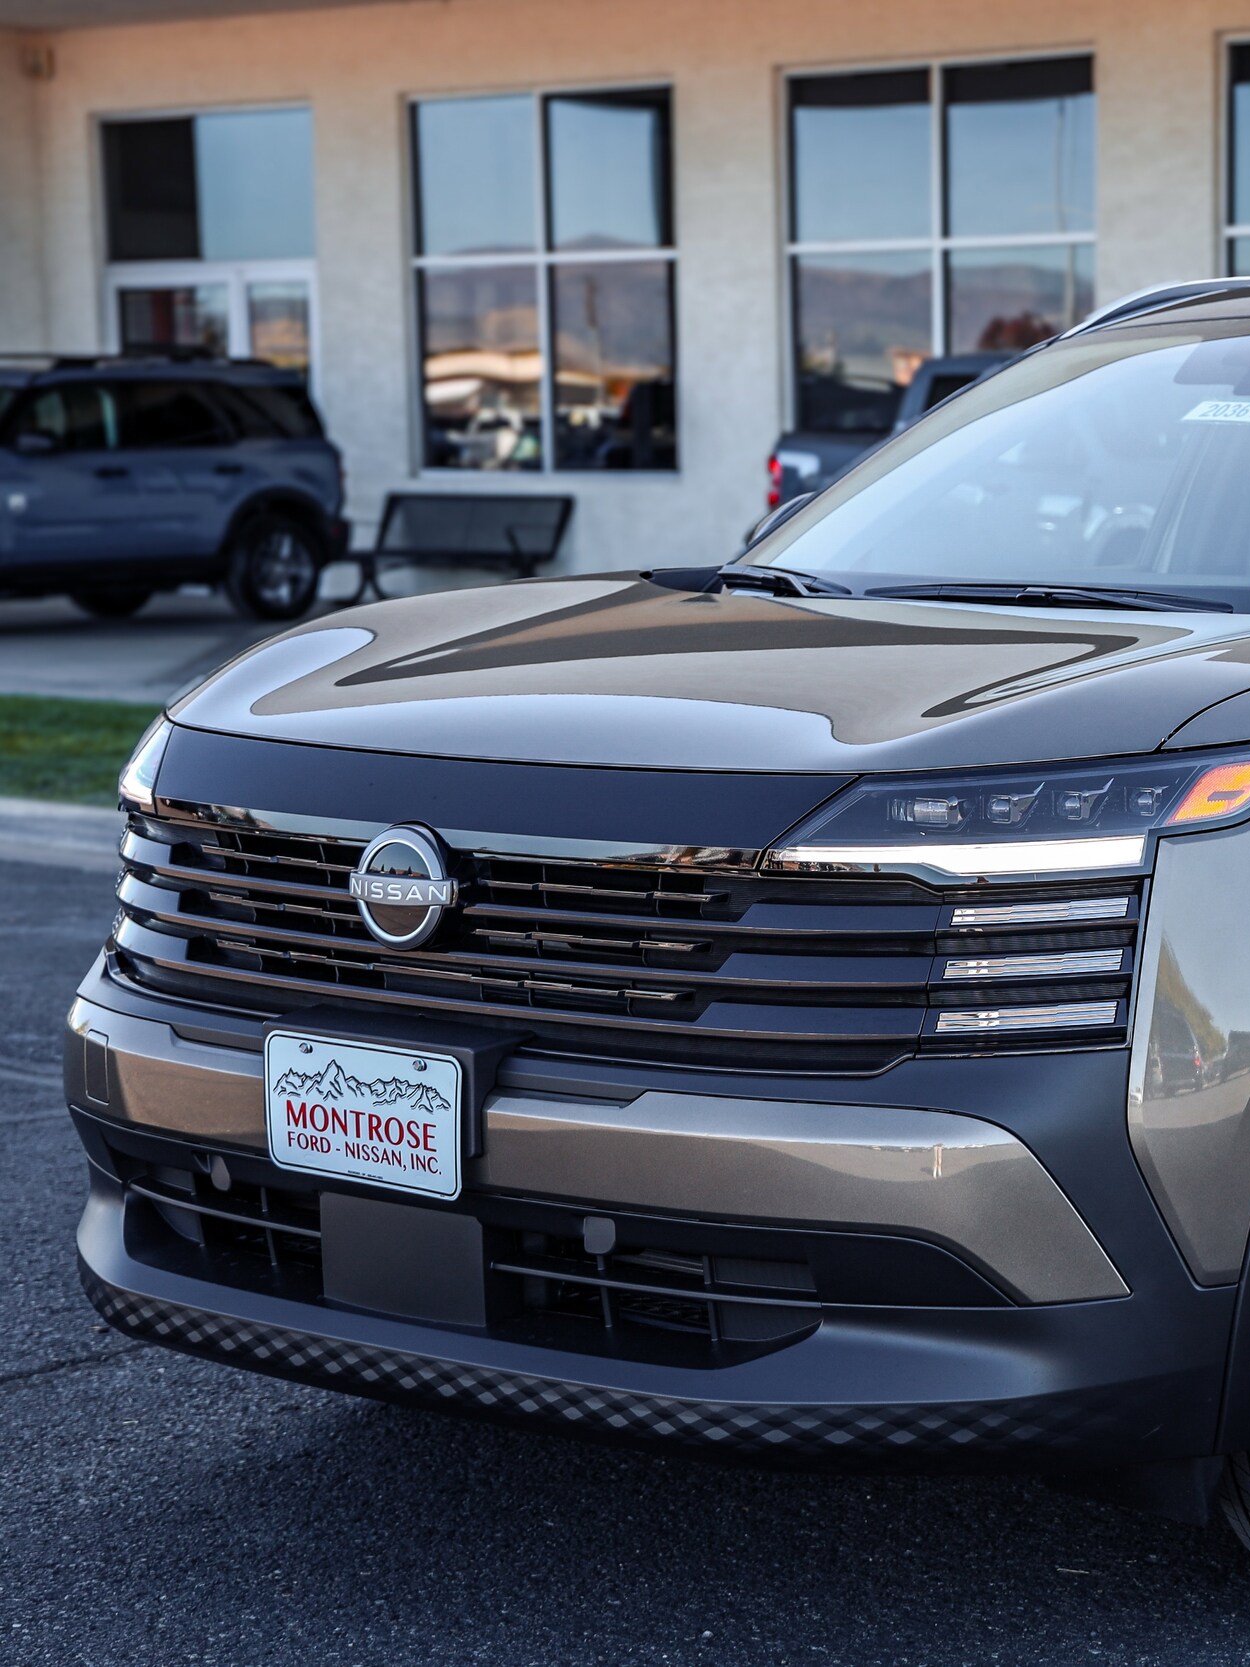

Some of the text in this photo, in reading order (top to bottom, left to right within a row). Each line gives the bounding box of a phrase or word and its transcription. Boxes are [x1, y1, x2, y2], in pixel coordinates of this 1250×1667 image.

[351, 877, 447, 901] NISSAN
[286, 1099, 437, 1152] MONTROSE
[287, 1131, 331, 1153] FORD
[345, 1141, 407, 1171] NISSAN,
[410, 1153, 442, 1175] INC.
